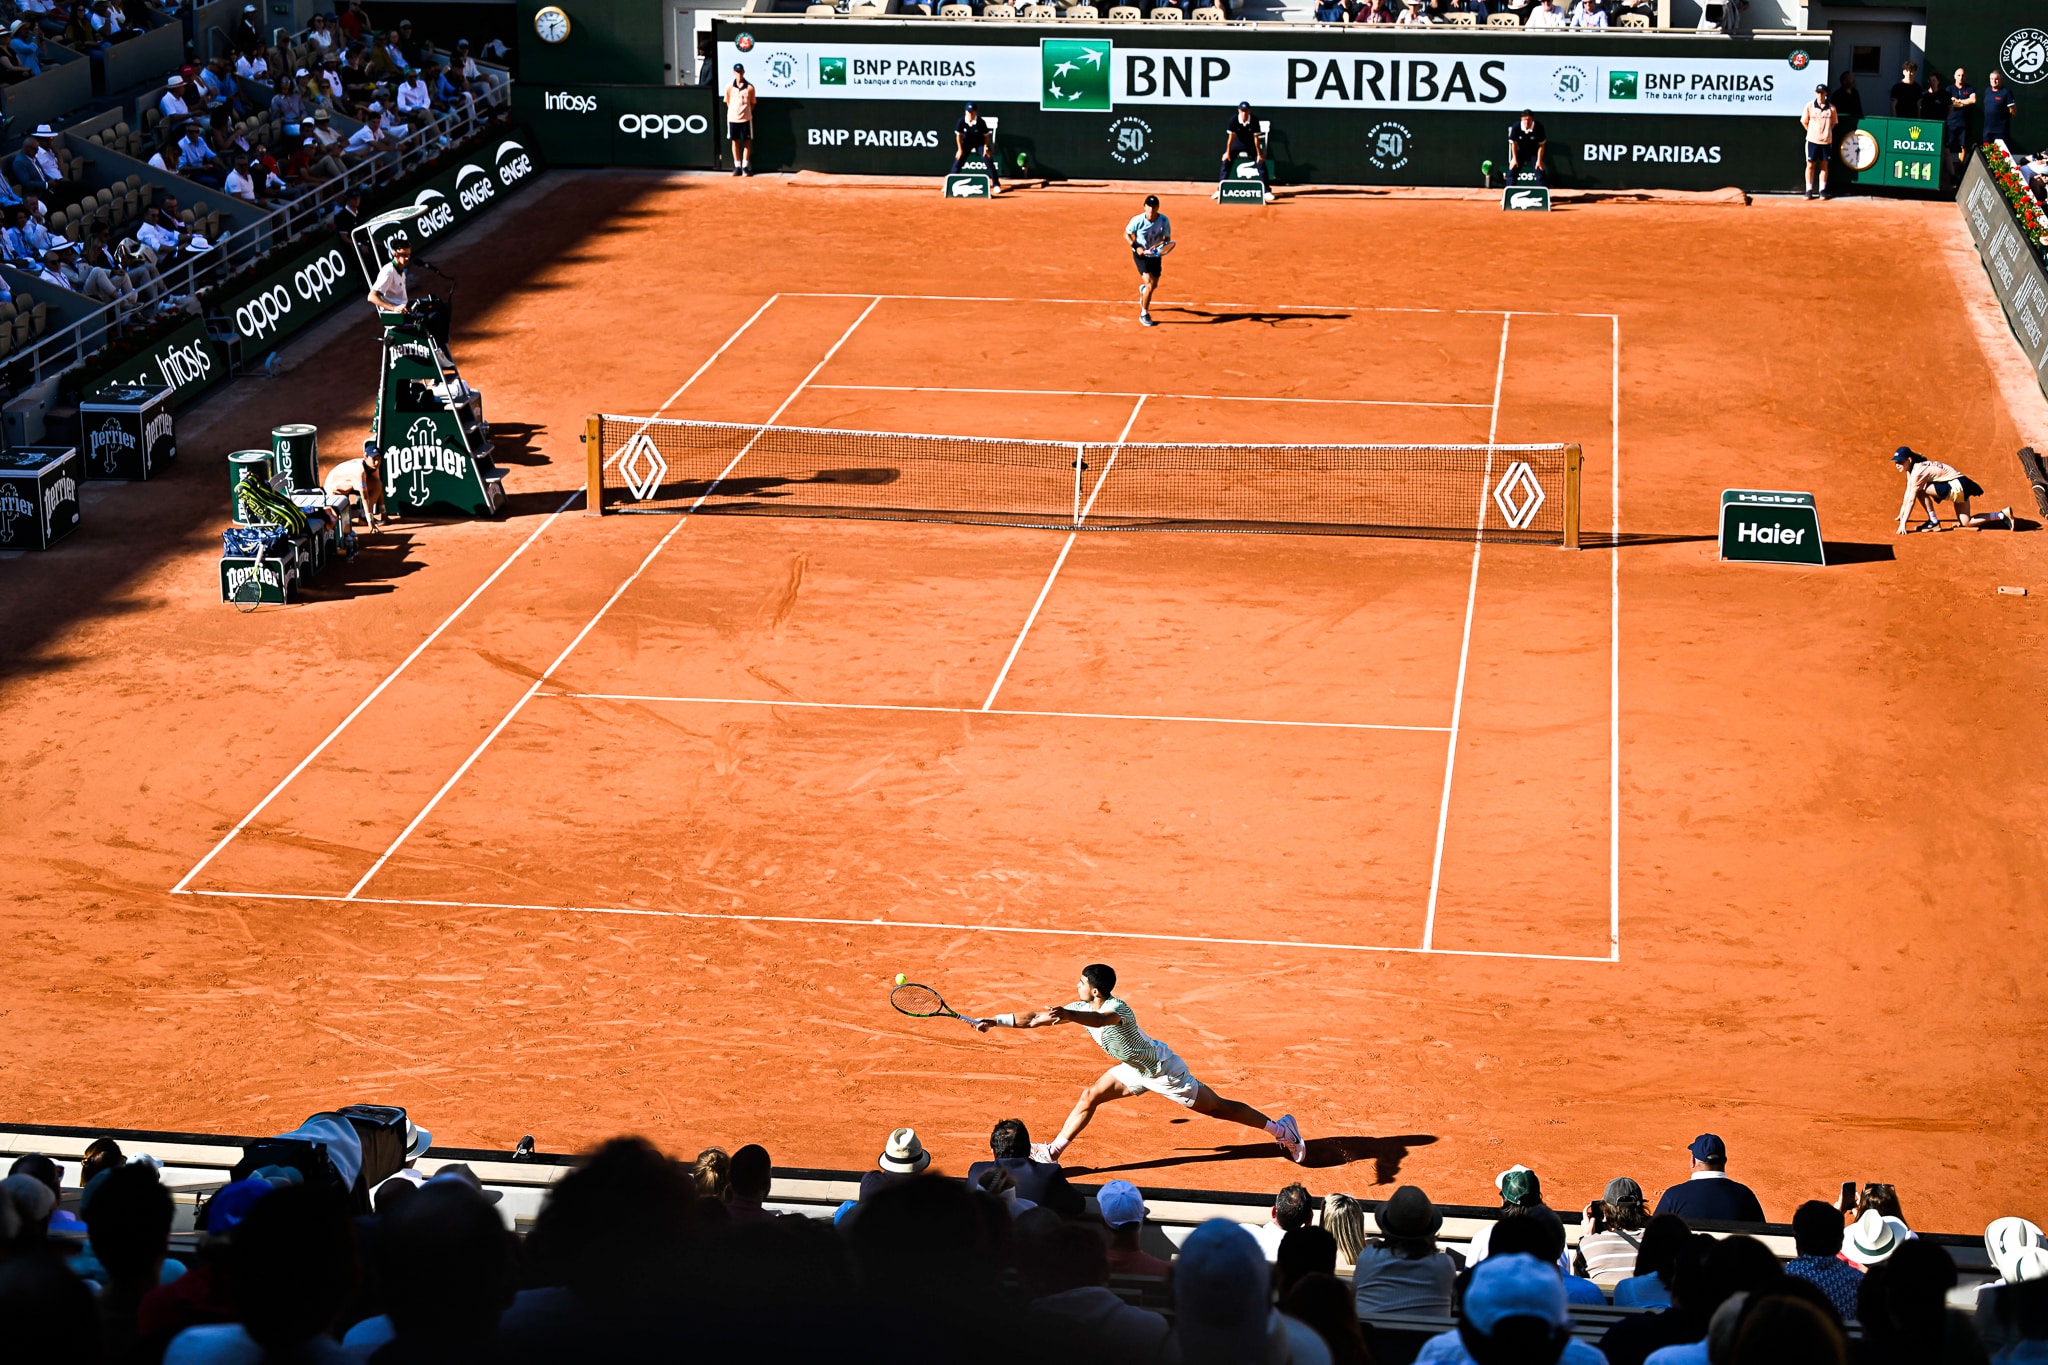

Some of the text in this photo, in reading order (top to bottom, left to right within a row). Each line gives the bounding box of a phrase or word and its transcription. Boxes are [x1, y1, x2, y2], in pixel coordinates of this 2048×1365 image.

[2002, 31, 2028, 62] ROLAND
[772, 60, 792, 78] 50
[853, 59, 976, 77] BNP PARIBAS
[2010, 69, 2045, 80] PARIS
[864, 78, 890, 86] banque
[950, 80, 977, 88] change
[1126, 55, 1507, 104] BNP PARIBAS
[1559, 75, 1580, 92] 50
[1645, 73, 1774, 92] BNP PARIBAS
[545, 91, 597, 114] Infosys
[1662, 92, 1683, 100] bank
[1685, 92, 1698, 101] for
[1707, 93, 1746, 102] changing
[618, 113, 708, 139] oppo
[807, 128, 939, 148] BNP PARIBAS
[1117, 128, 1144, 152] 50
[1376, 133, 1403, 157] 50
[1893, 139, 1935, 152] ROLEX
[1583, 143, 1722, 164] BNP PARIBAS
[1893, 160, 1932, 181] 1:44
[1222, 189, 1262, 198] LACOSTE
[294, 249, 346, 303] oppo
[236, 284, 292, 340] oppo
[155, 338, 211, 392] Infosys
[1738, 493, 1805, 504] Haier
[1738, 522, 1805, 545] Haier
